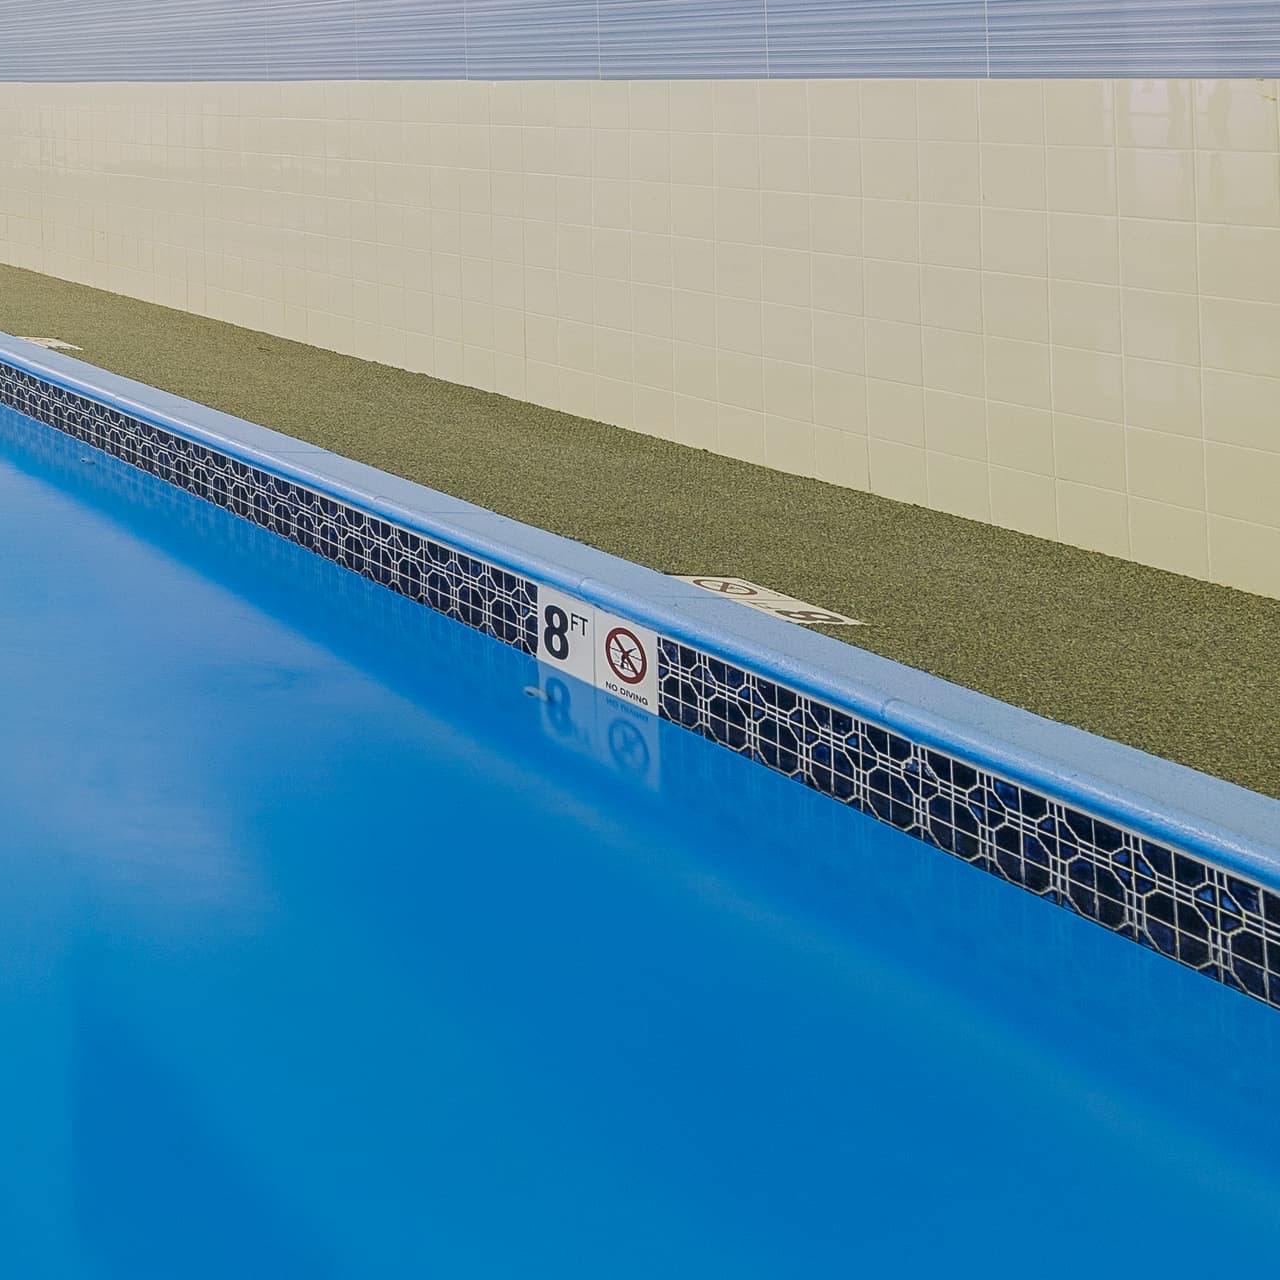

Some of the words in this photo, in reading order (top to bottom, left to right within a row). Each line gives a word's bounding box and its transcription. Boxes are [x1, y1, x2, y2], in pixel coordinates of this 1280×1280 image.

[544, 605, 569, 660] 8
[570, 613, 588, 636] FT
[605, 681, 618, 692] NO
[620, 687, 648, 706] DIVING
